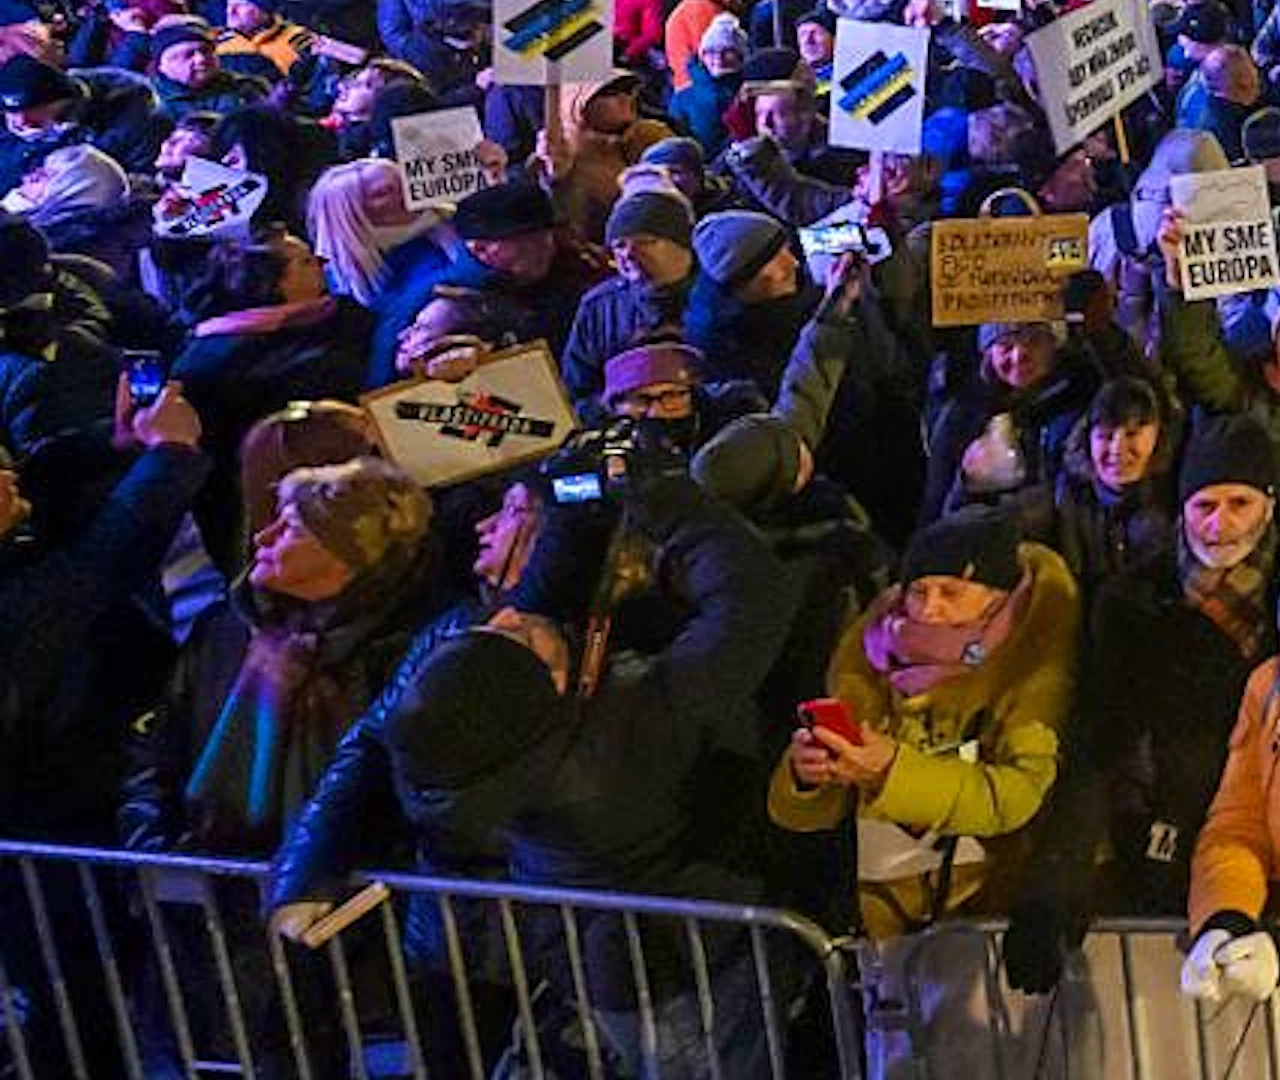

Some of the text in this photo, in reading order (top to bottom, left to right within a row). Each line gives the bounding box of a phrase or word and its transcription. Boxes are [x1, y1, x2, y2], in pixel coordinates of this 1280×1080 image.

[405, 156, 437, 179] MY
[1185, 222, 1269, 257] MY SME
